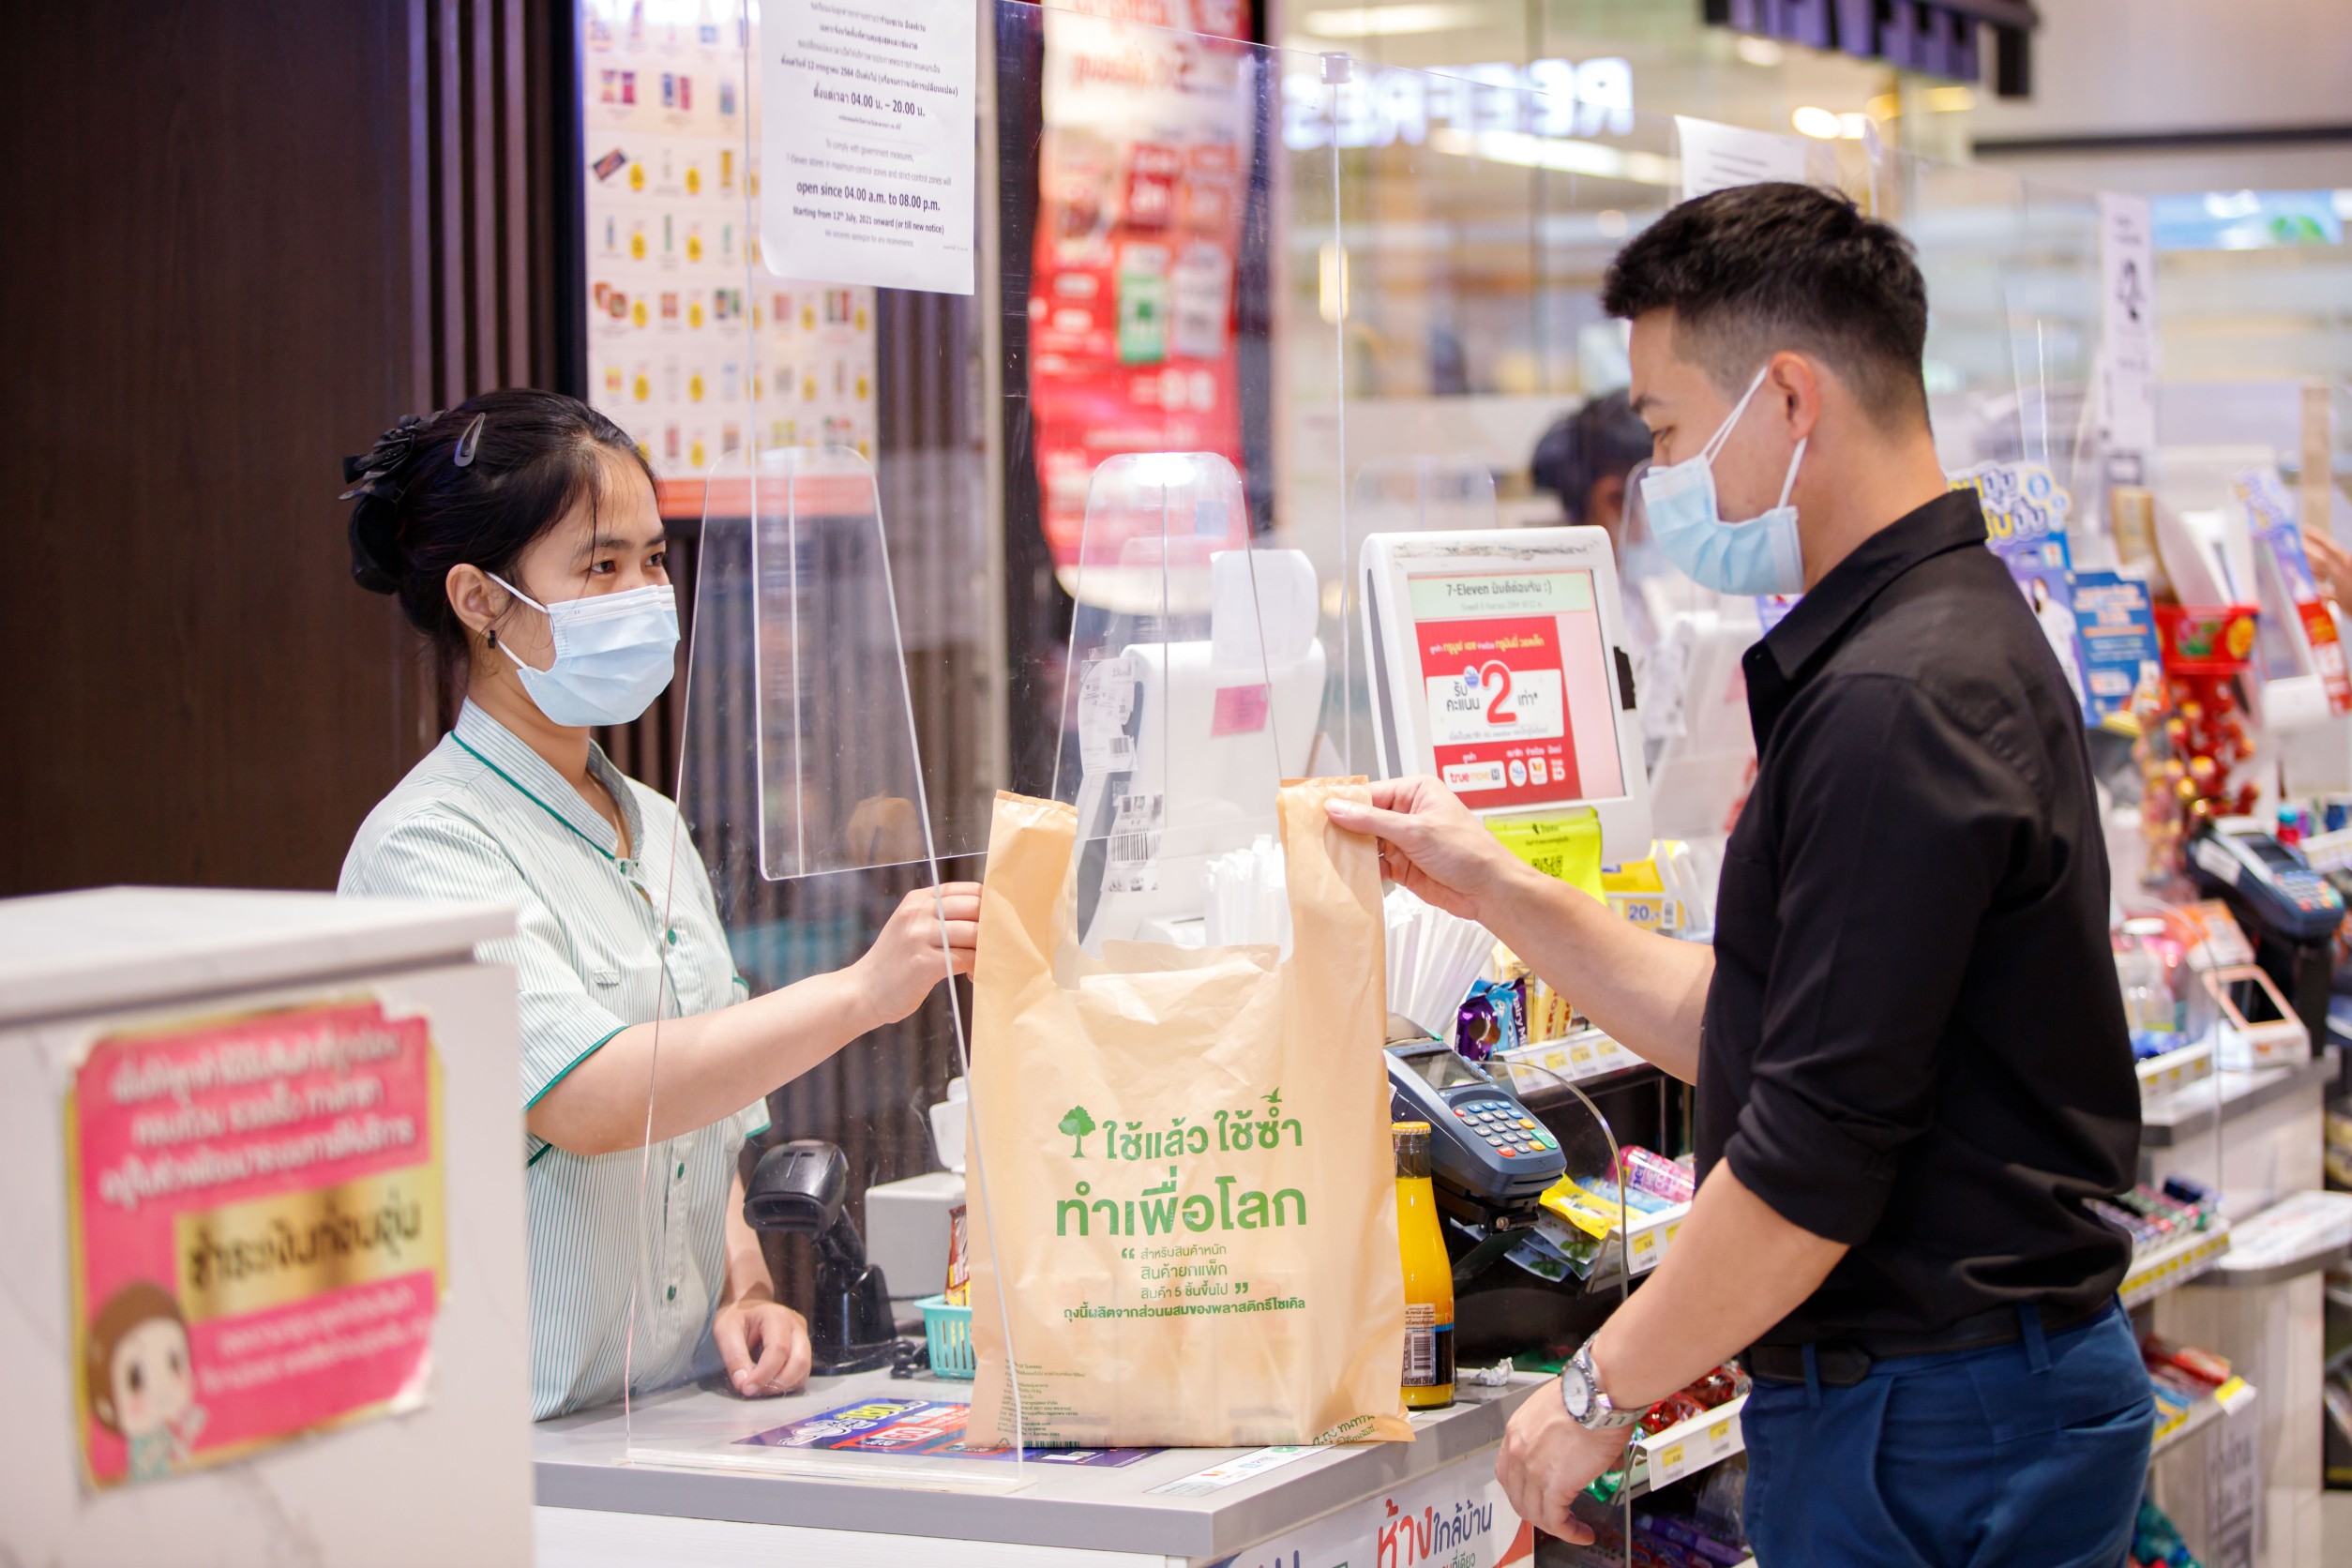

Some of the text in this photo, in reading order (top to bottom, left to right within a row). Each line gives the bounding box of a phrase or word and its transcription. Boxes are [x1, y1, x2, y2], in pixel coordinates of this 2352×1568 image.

[841, 67, 853, 77] 2564
[851, 92, 873, 108] 04.00
[875, 99, 882, 110] น.
[893, 99, 915, 115] 20.00
[917, 107, 926, 117] น.
[797, 182, 941, 213] open since 04.00 a.m. to 08.00 p.m.
[793, 206, 816, 219] Starting
[818, 208, 832, 219] from
[859, 215, 872, 225] 2021
[873, 219, 895, 228] onward
[913, 223, 924, 232] new
[925, 224, 944, 235] notice)
[1445, 582, 1490, 596] 7-Eleven
[1454, 681, 1469, 698] รับ
[1481, 660, 1518, 725] 2
[1446, 698, 1481, 713] คะแนน
[1102, 1116, 1209, 1161] ใช้แล้ว
[1056, 1165, 1306, 1236] ทำเพื่อโลก
[1140, 1244, 1227, 1259] สำหรับสินค้าหนัก
[1140, 1259, 1228, 1280] สินค้ายกแพ็ก
[1140, 1286, 1172, 1300] สินค้า
[1174, 1285, 1182, 1298] 5
[1184, 1280, 1229, 1297] ชิ้นขึ้นไป
[1063, 1297, 1305, 1323] ถุงนี้ผลิตจากส่วนผสมของพลาสติกรีไซเคิล
